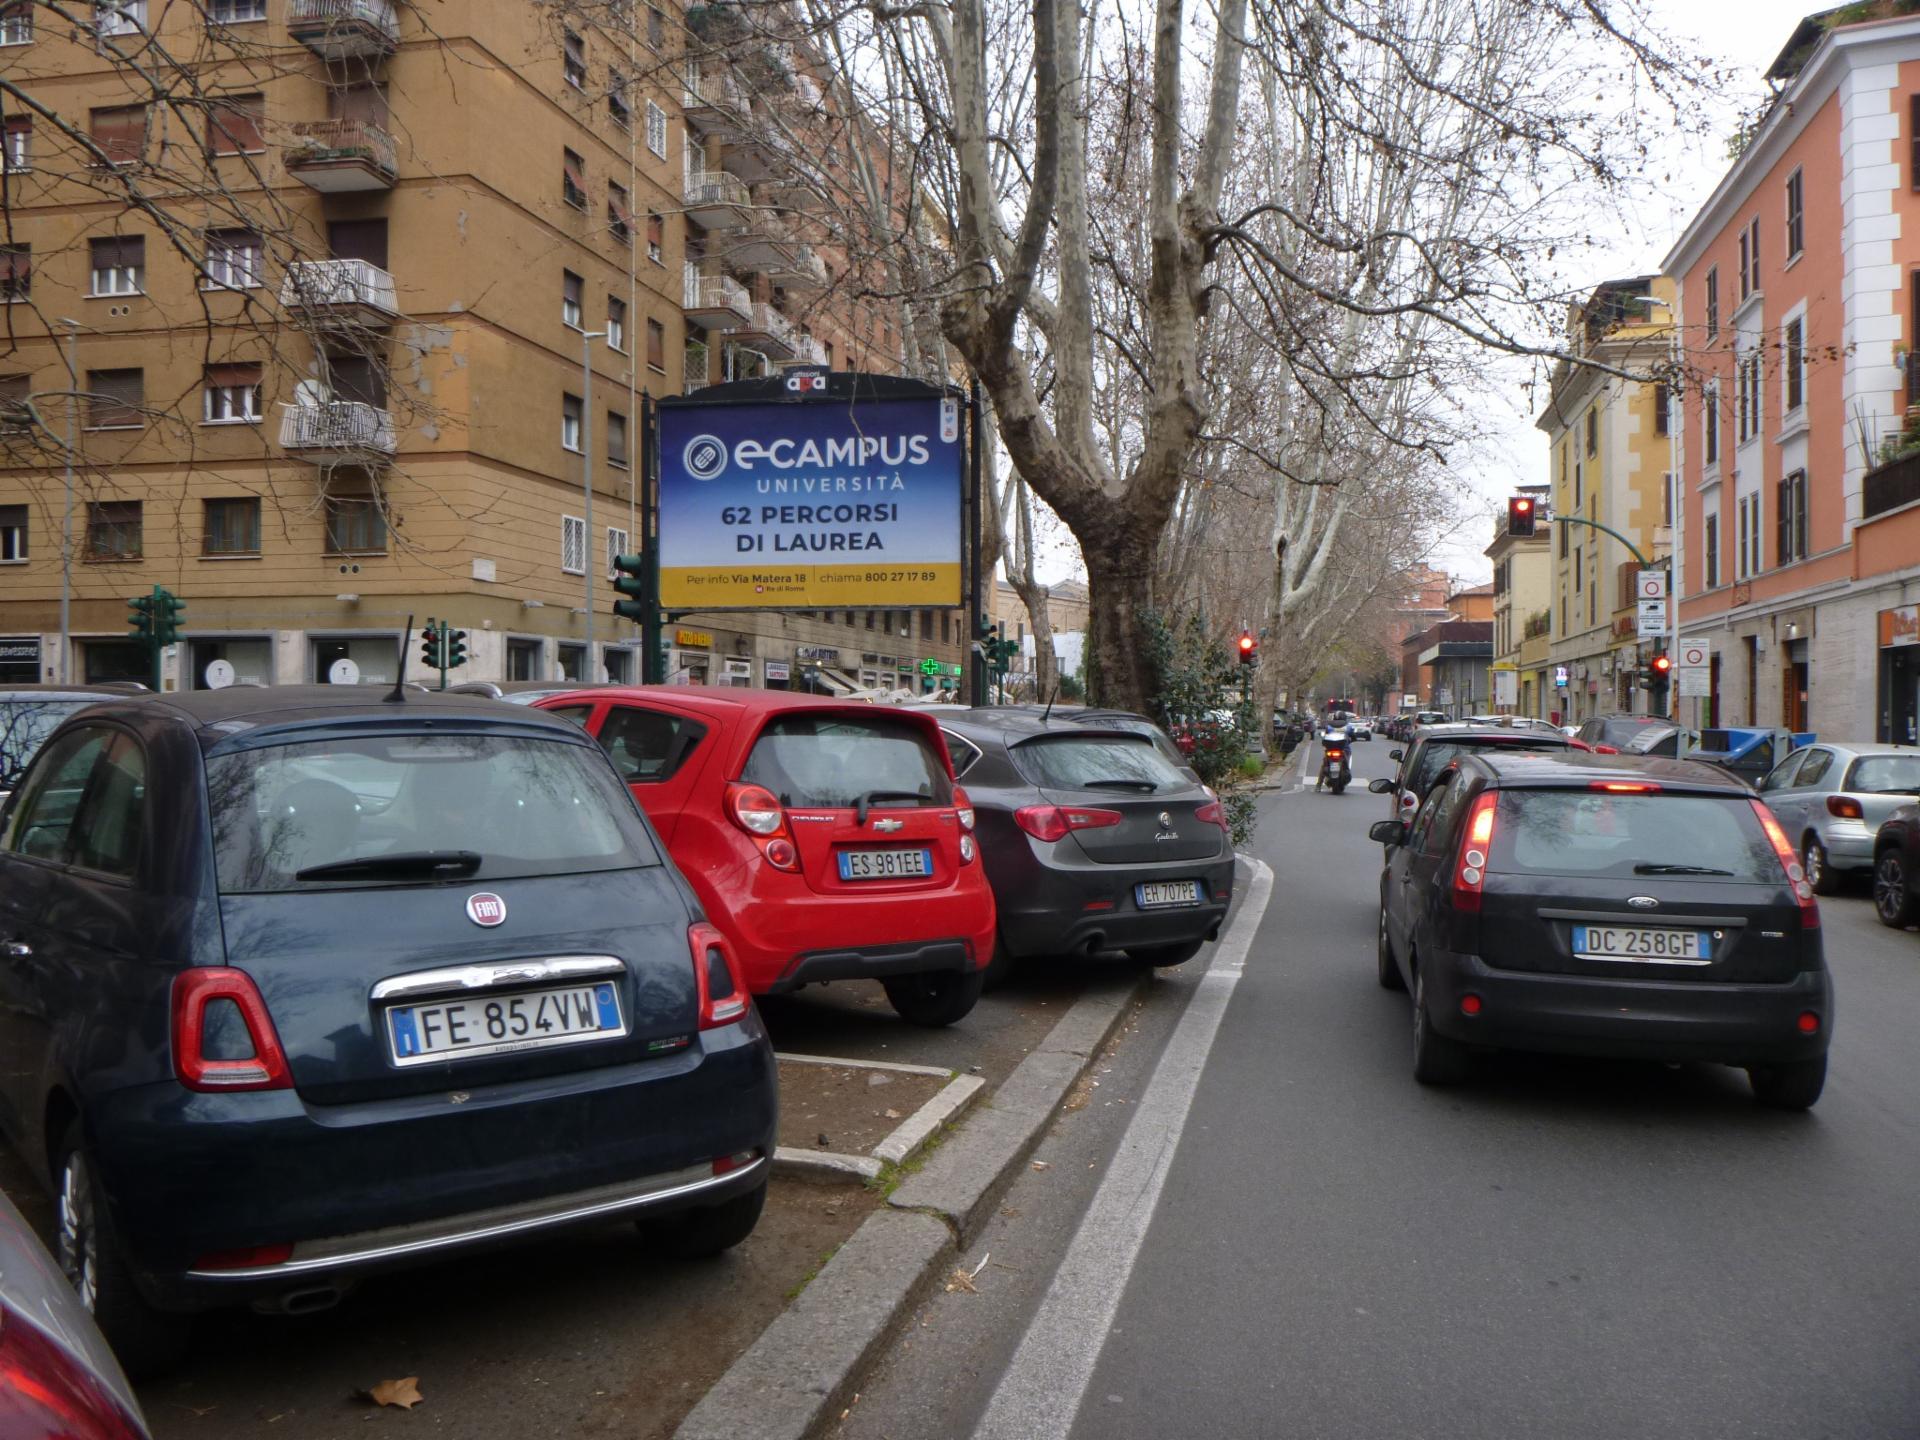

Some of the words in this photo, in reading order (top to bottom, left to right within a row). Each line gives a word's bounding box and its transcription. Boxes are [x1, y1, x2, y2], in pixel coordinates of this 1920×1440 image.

[757, 472, 905, 494] UNIVERSITÀ
[721, 506, 752, 526] 62
[761, 503, 898, 525] PERCORSI
[736, 534, 763, 552] DI
[774, 532, 884, 552] LAUREA
[686, 575, 705, 585] Per
[707, 574, 730, 584] info
[731, 574, 749, 584] Via
[752, 573, 792, 583] Matera
[794, 573, 807, 583] 18
[819, 572, 863, 583] chiama
[865, 572, 888, 582] 800
[890, 572, 905, 582] 27
[906, 572, 919, 582] 17
[920, 571, 936, 582] 89
[851, 855, 870, 876] ES
[876, 853, 923, 875] 981EE
[1143, 885, 1160, 902] EH
[1161, 882, 1196, 901] 707PE
[474, 902, 499, 917] FIAT
[1589, 930, 1617, 952] DC
[1625, 931, 1695, 956] 258GF
[421, 1005, 471, 1050] FE
[485, 990, 598, 1040] 854VW
